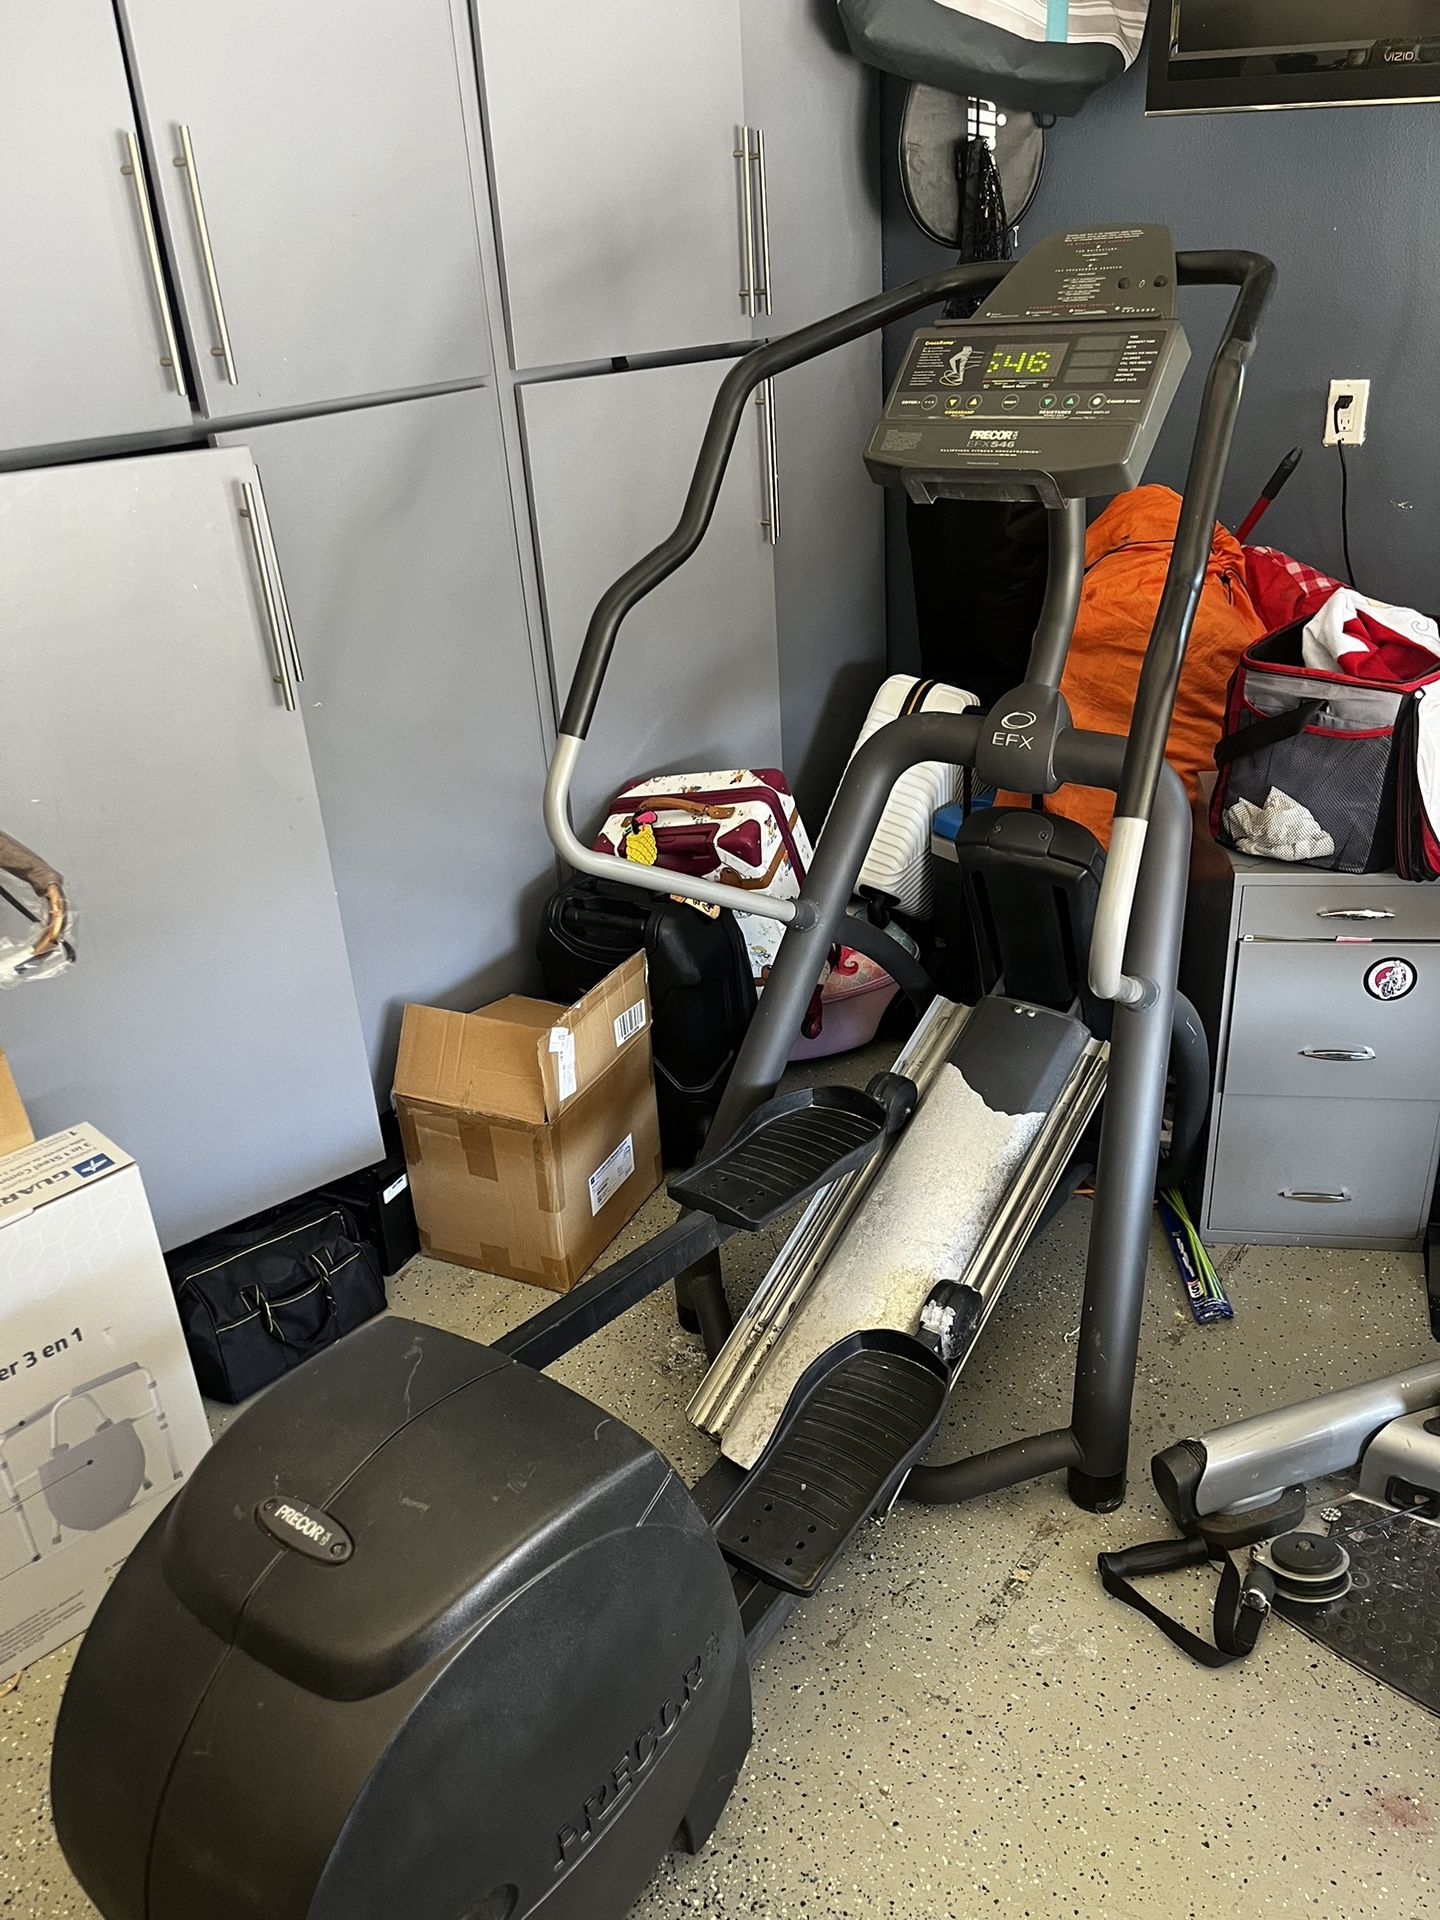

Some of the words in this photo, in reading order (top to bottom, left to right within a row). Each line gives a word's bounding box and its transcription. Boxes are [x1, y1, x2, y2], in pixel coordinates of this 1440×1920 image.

[1384, 46, 1415, 62] VIZIO
[969, 430, 1013, 440] PRECOR
[992, 731, 1034, 750] EFX
[32, 1155, 63, 1170] Steel
[0, 1170, 71, 1207] GUAR
[0, 1360, 19, 1381] er
[22, 1351, 38, 1368] 3
[42, 1337, 69, 1358] en
[71, 1327, 83, 1342] 1
[274, 1504, 325, 1541] PRECOR
